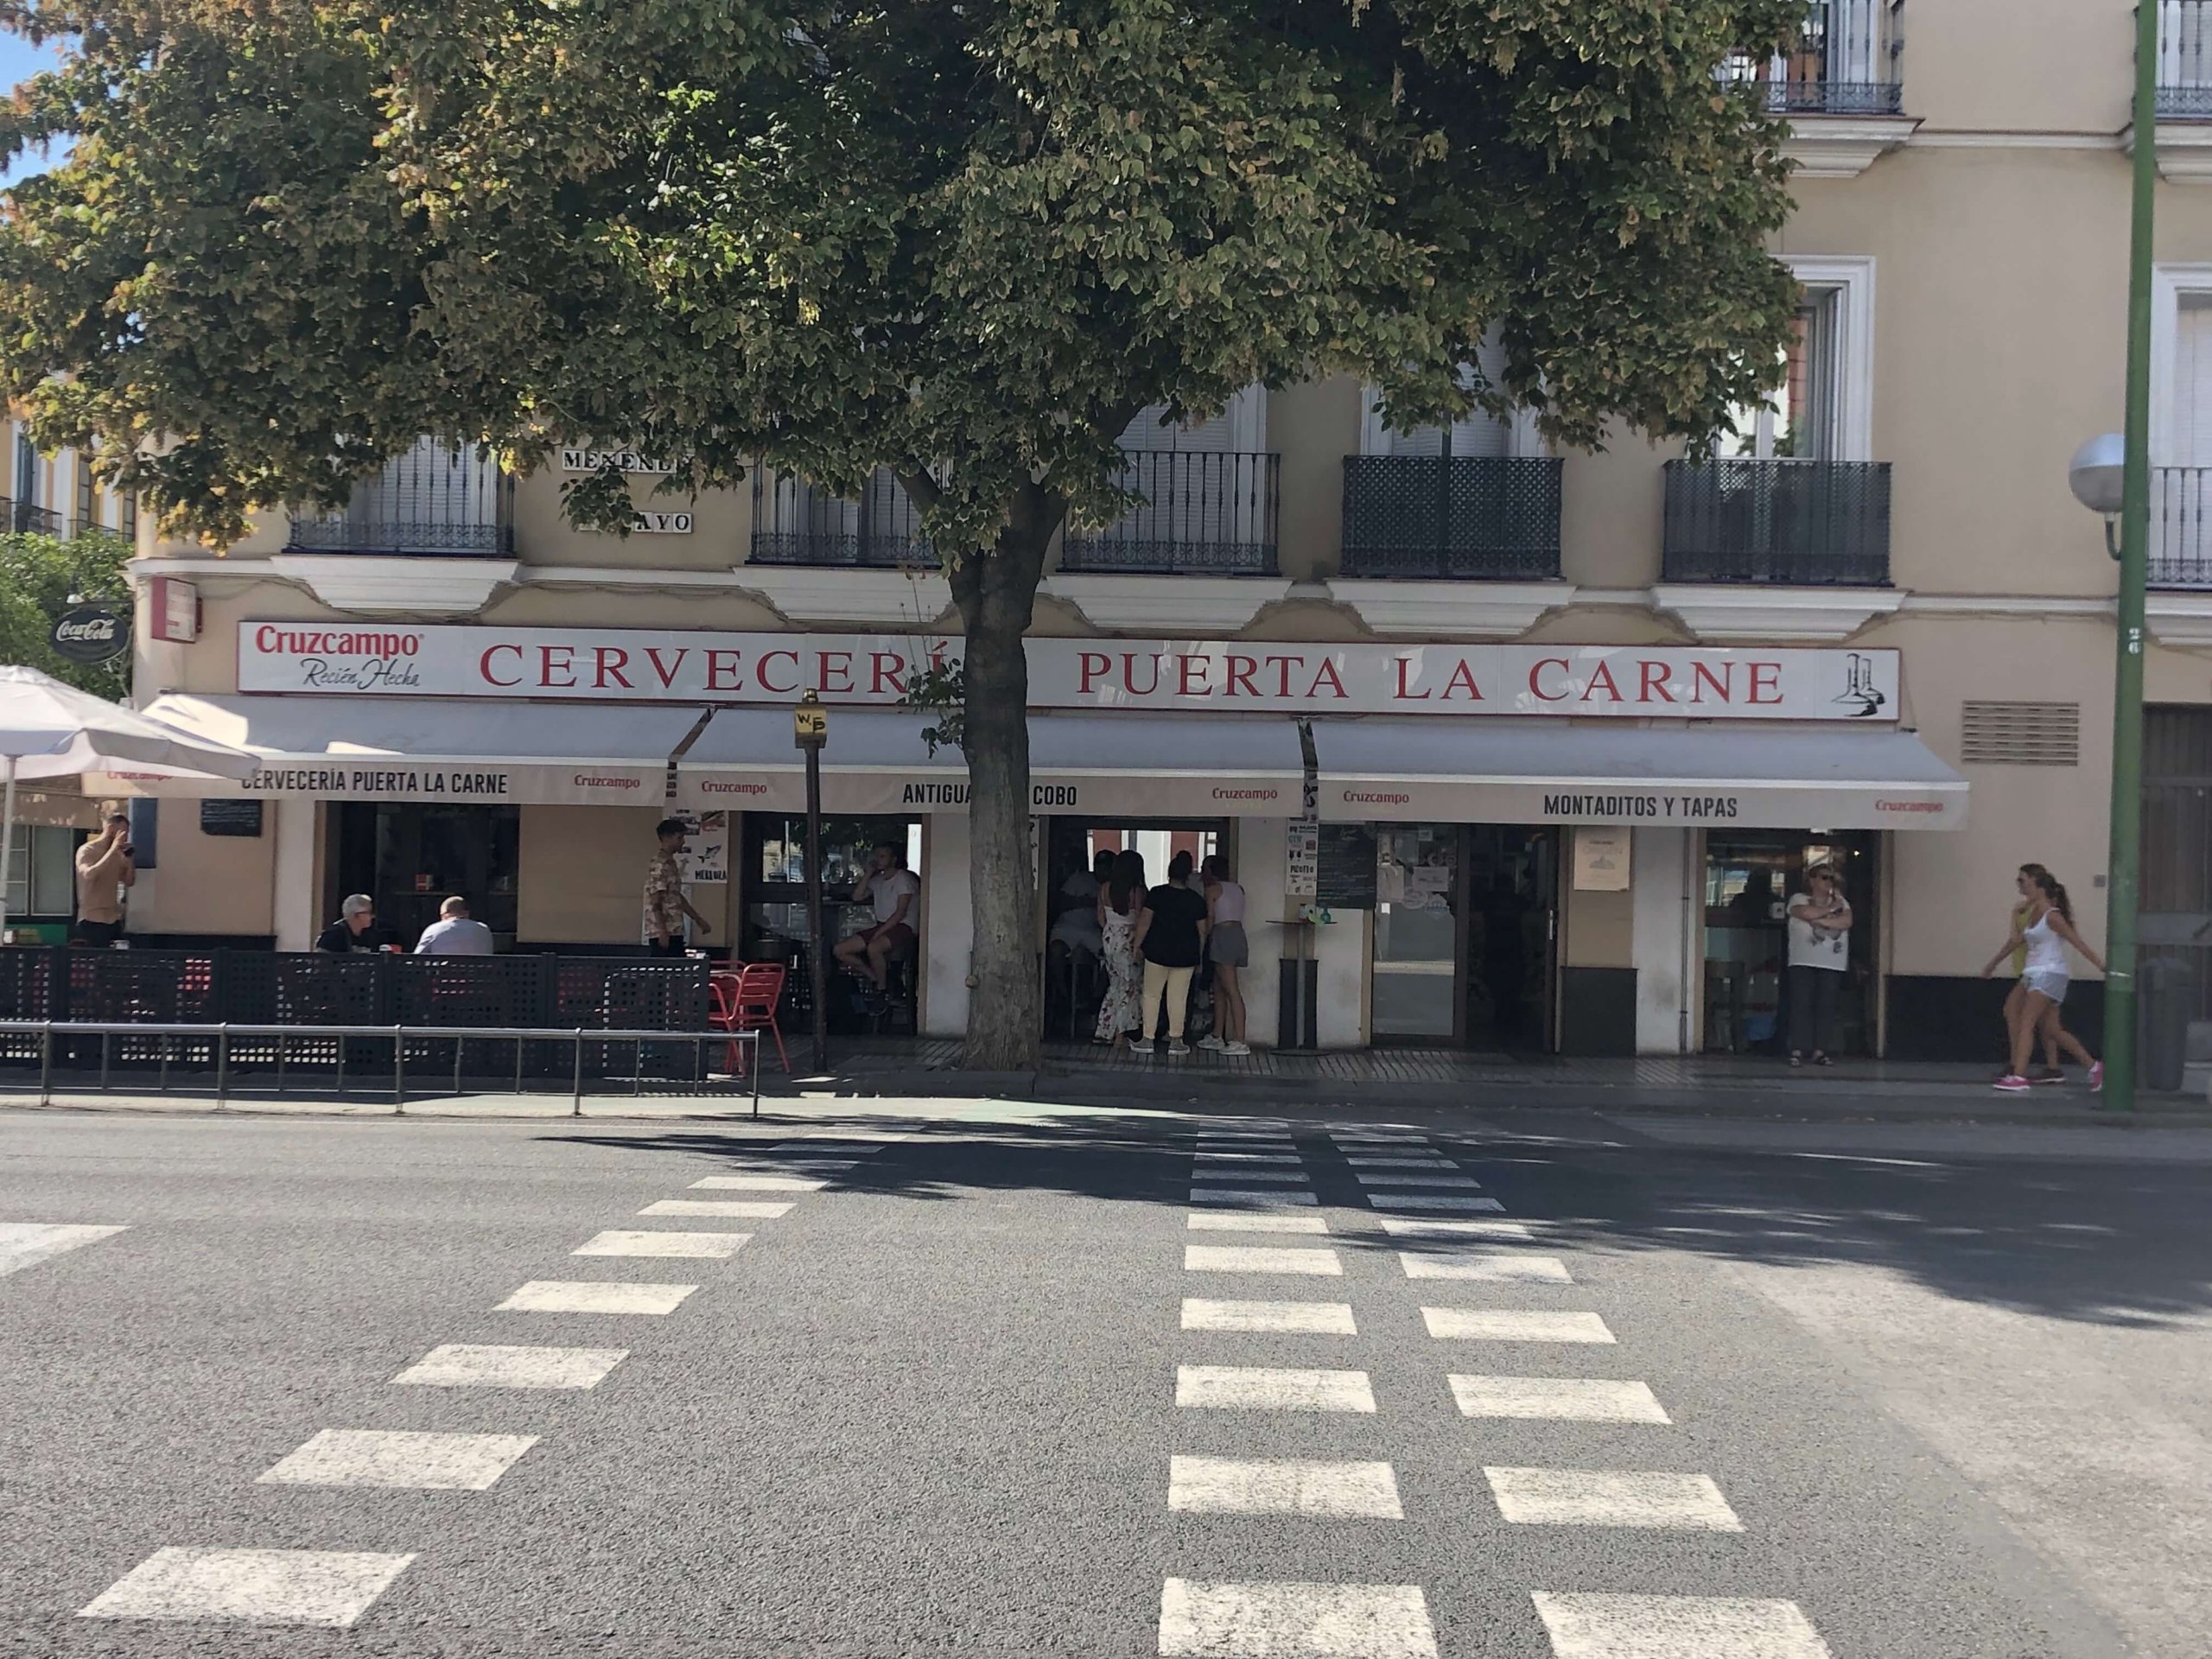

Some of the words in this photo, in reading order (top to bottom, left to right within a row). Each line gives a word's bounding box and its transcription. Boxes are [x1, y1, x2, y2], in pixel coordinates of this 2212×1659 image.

[256, 625, 419, 661] Cruzcampo
[300, 658, 359, 687] Recién
[357, 658, 421, 690] Hecha
[480, 640, 949, 694] CERVECERÍ
[1077, 652, 1350, 699] PUERTA
[1393, 657, 1485, 701] LA
[1529, 658, 1785, 704] CARNE
[353, 771, 417, 792] PUERTA
[423, 772, 445, 792] LA
[451, 773, 507, 794] CARNE
[574, 774, 640, 790] Cruzcampo
[701, 780, 767, 795] Cruzcampo
[1033, 785, 1077, 805] COBO
[1212, 787, 1278, 801] Cruzcampo
[1343, 791, 1409, 805] Cruzcampo
[1544, 795, 1656, 817] MONTADITOS
[1664, 798, 1675, 817] Y
[1682, 798, 1738, 817] TAPAS
